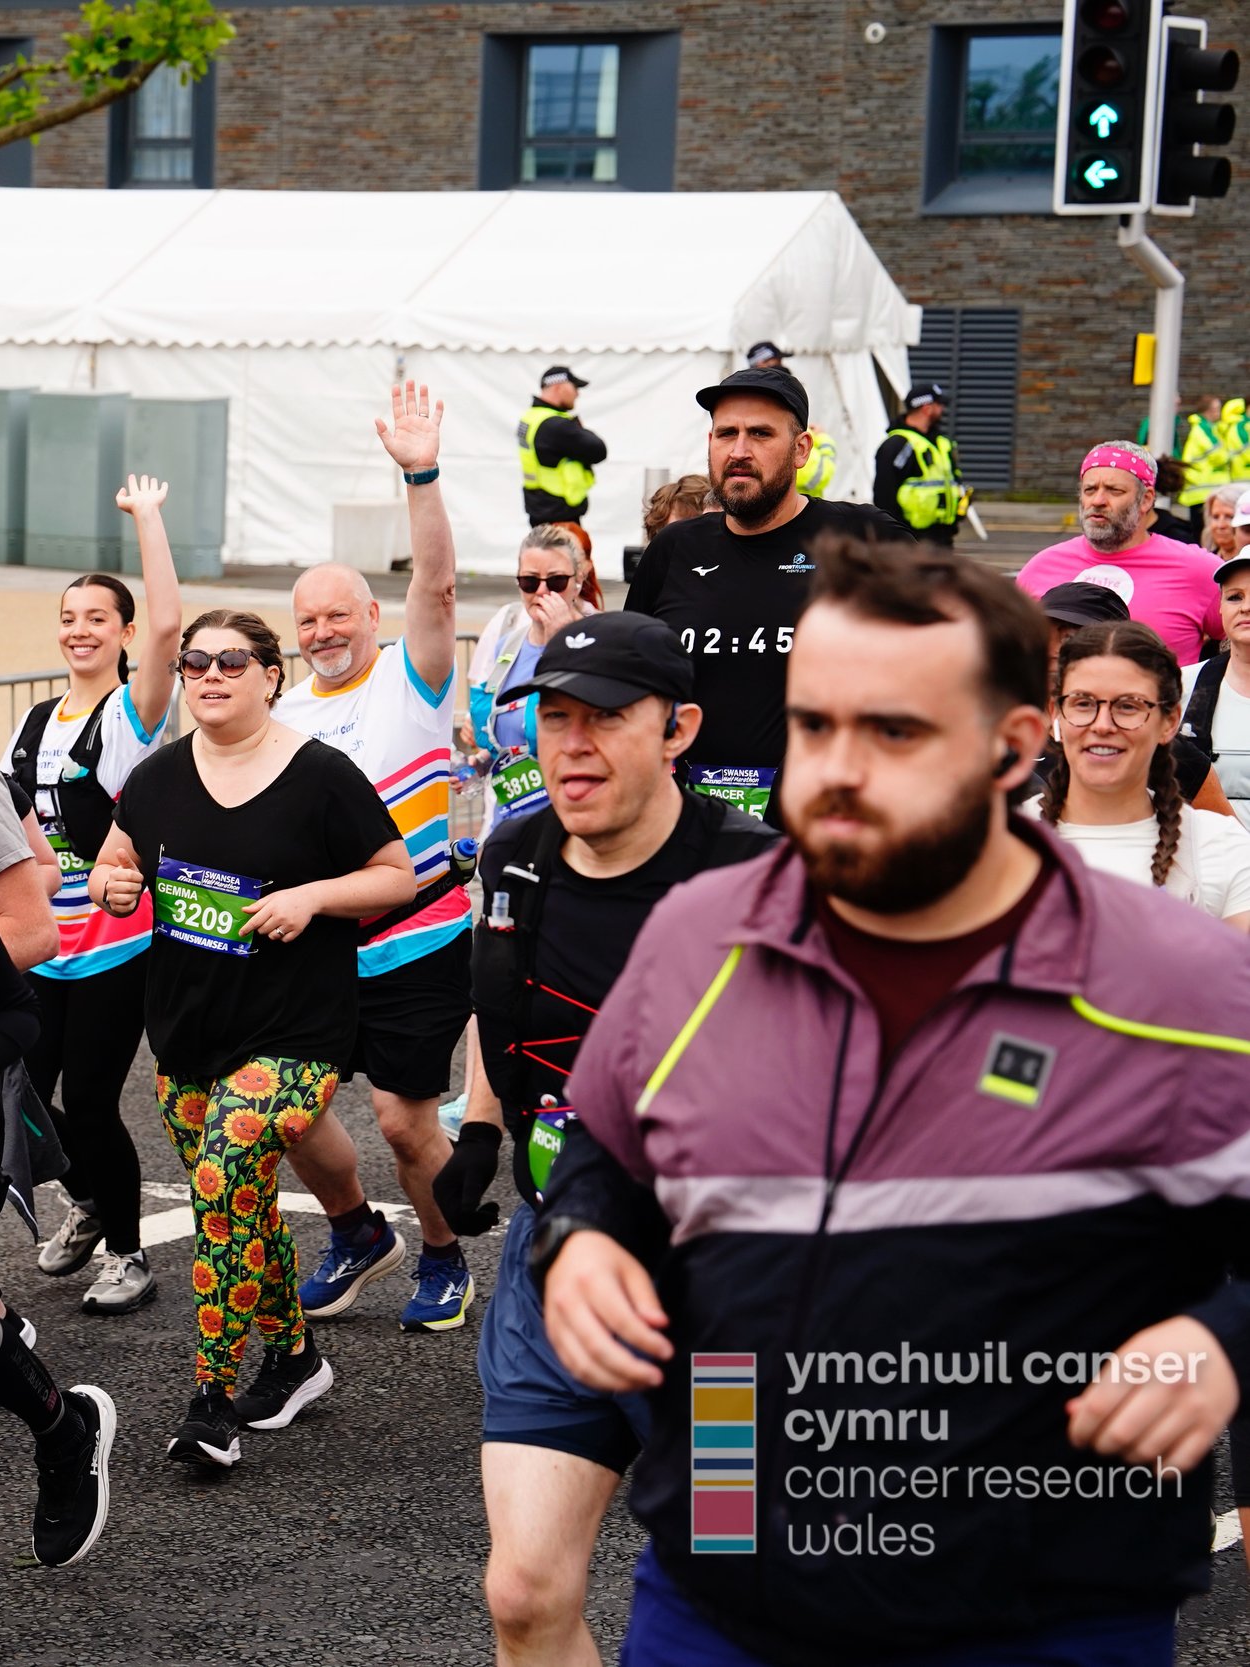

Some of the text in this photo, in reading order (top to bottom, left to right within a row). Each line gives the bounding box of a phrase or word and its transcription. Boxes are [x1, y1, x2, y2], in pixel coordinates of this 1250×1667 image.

[681, 627, 795, 654] 02:45
[724, 769, 759, 777] SWANSEA
[502, 769, 543, 799] 3819
[709, 788, 744, 800] PACER
[202, 878, 216, 886] Half
[213, 881, 240, 891] Marathon
[205, 870, 240, 885] SWANSEA
[158, 882, 198, 901] GEMMA
[172, 899, 233, 934] 3209
[170, 929, 229, 951] #RUNSWANSEA
